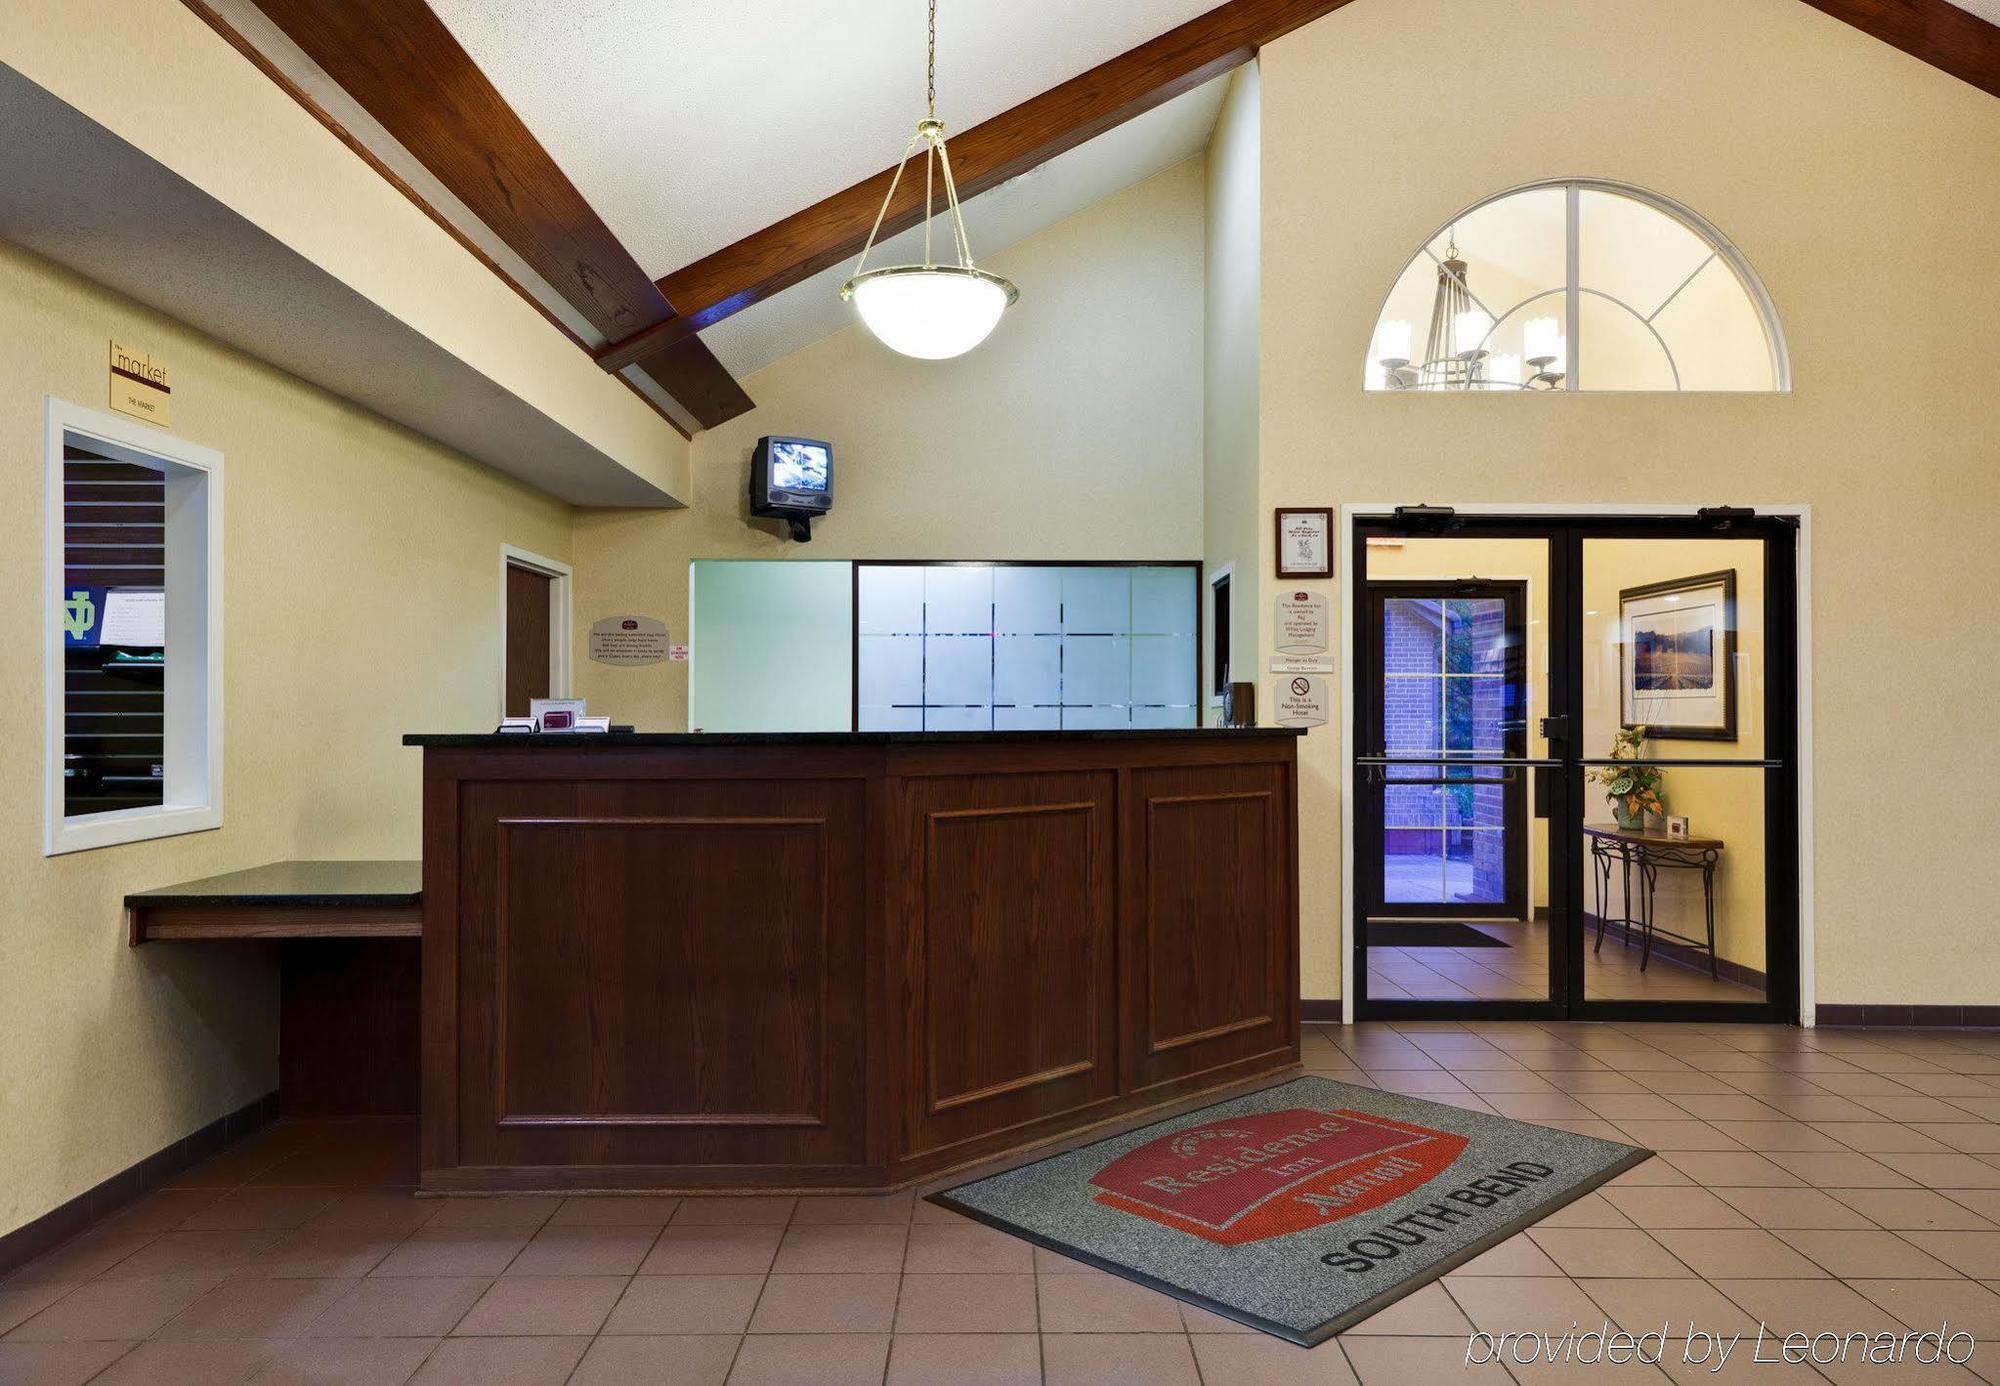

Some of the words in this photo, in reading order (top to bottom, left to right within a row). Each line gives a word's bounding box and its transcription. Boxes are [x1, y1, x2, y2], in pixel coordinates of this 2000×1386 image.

[118, 354, 167, 386] market
[128, 396, 137, 407] THE
[137, 399, 155, 412] MARKET
[1281, 703, 1320, 712] Non-Smoking
[1140, 1117, 1352, 1196] Residence
[1277, 1154, 1327, 1179] Inn
[1320, 1199, 1464, 1274] SOUTH
[1462, 1160, 1554, 1209] BEND
